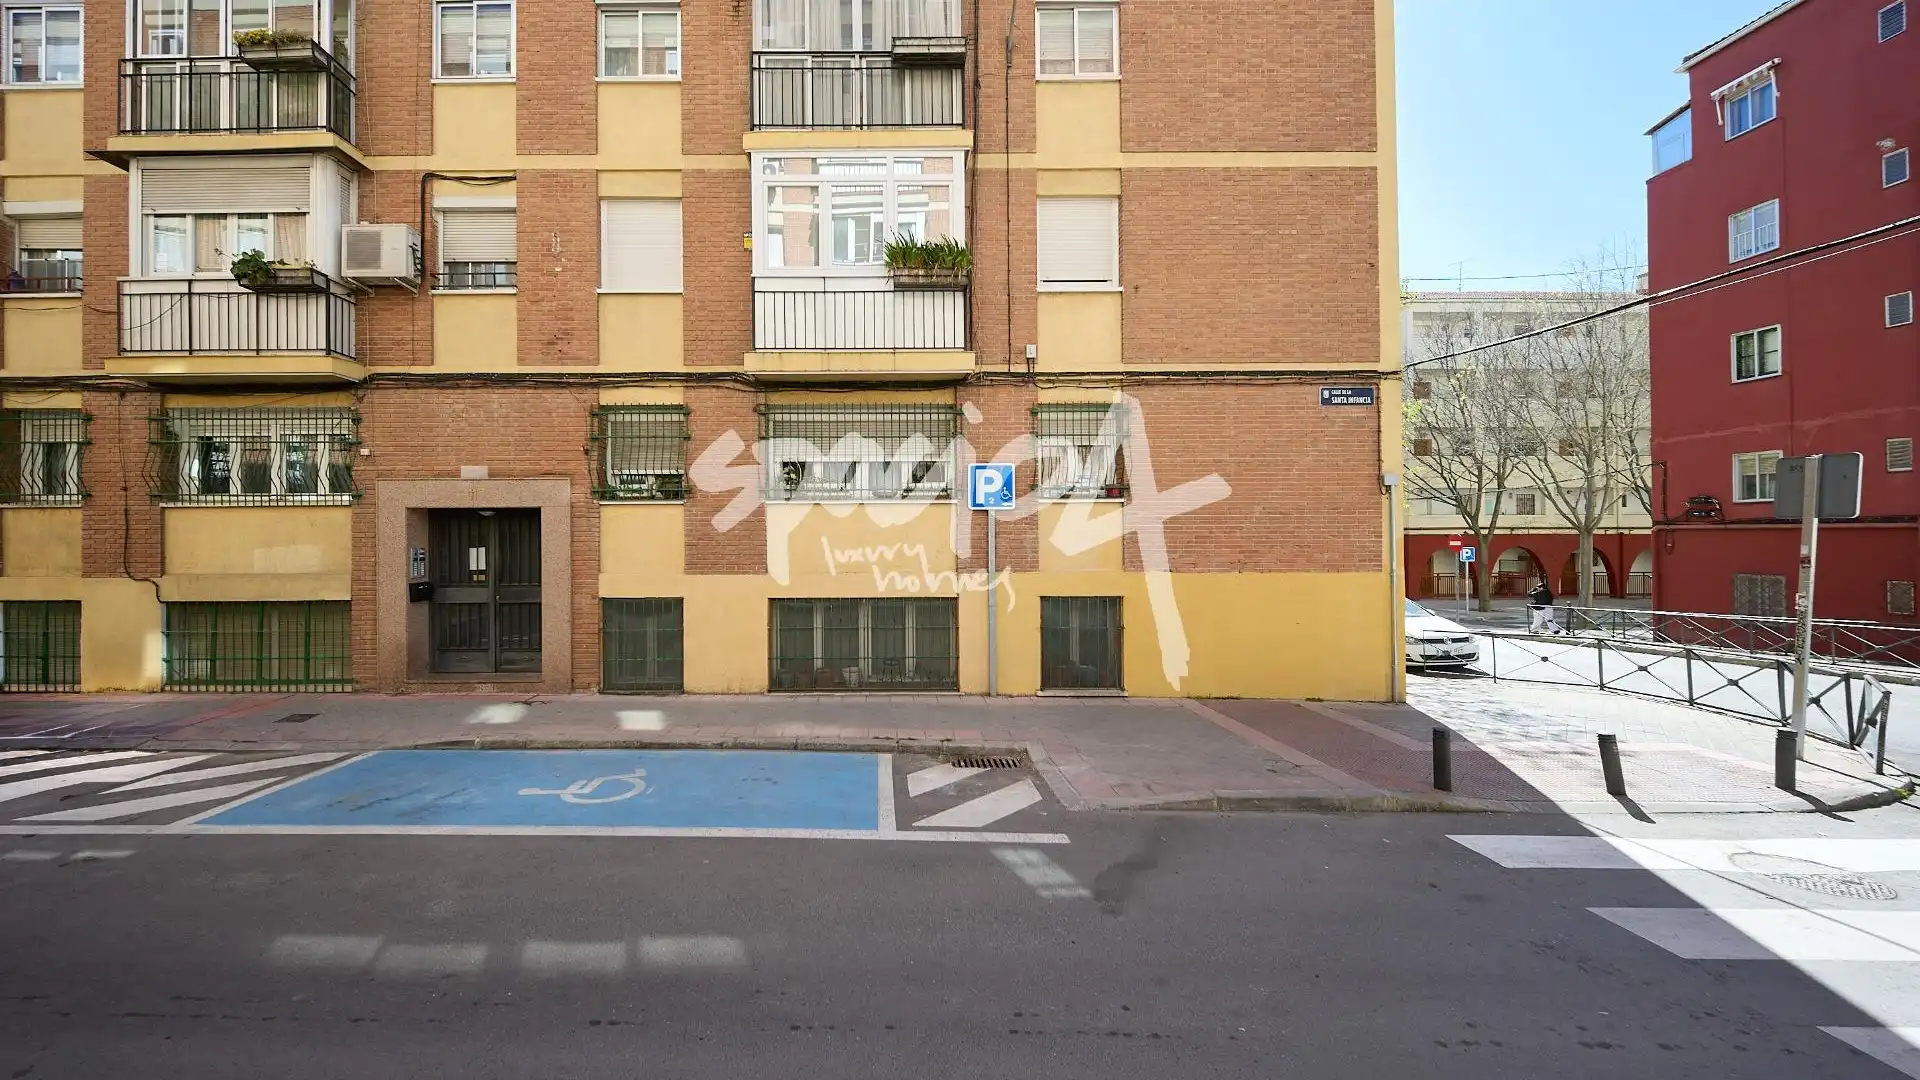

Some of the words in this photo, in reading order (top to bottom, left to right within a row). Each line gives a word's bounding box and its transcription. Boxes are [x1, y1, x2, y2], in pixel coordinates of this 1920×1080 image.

[1331, 396, 1347, 404] SANTA
[1348, 396, 1371, 404] INFANCIA
[976, 469, 1003, 504] P
[1462, 549, 1472, 560] P
